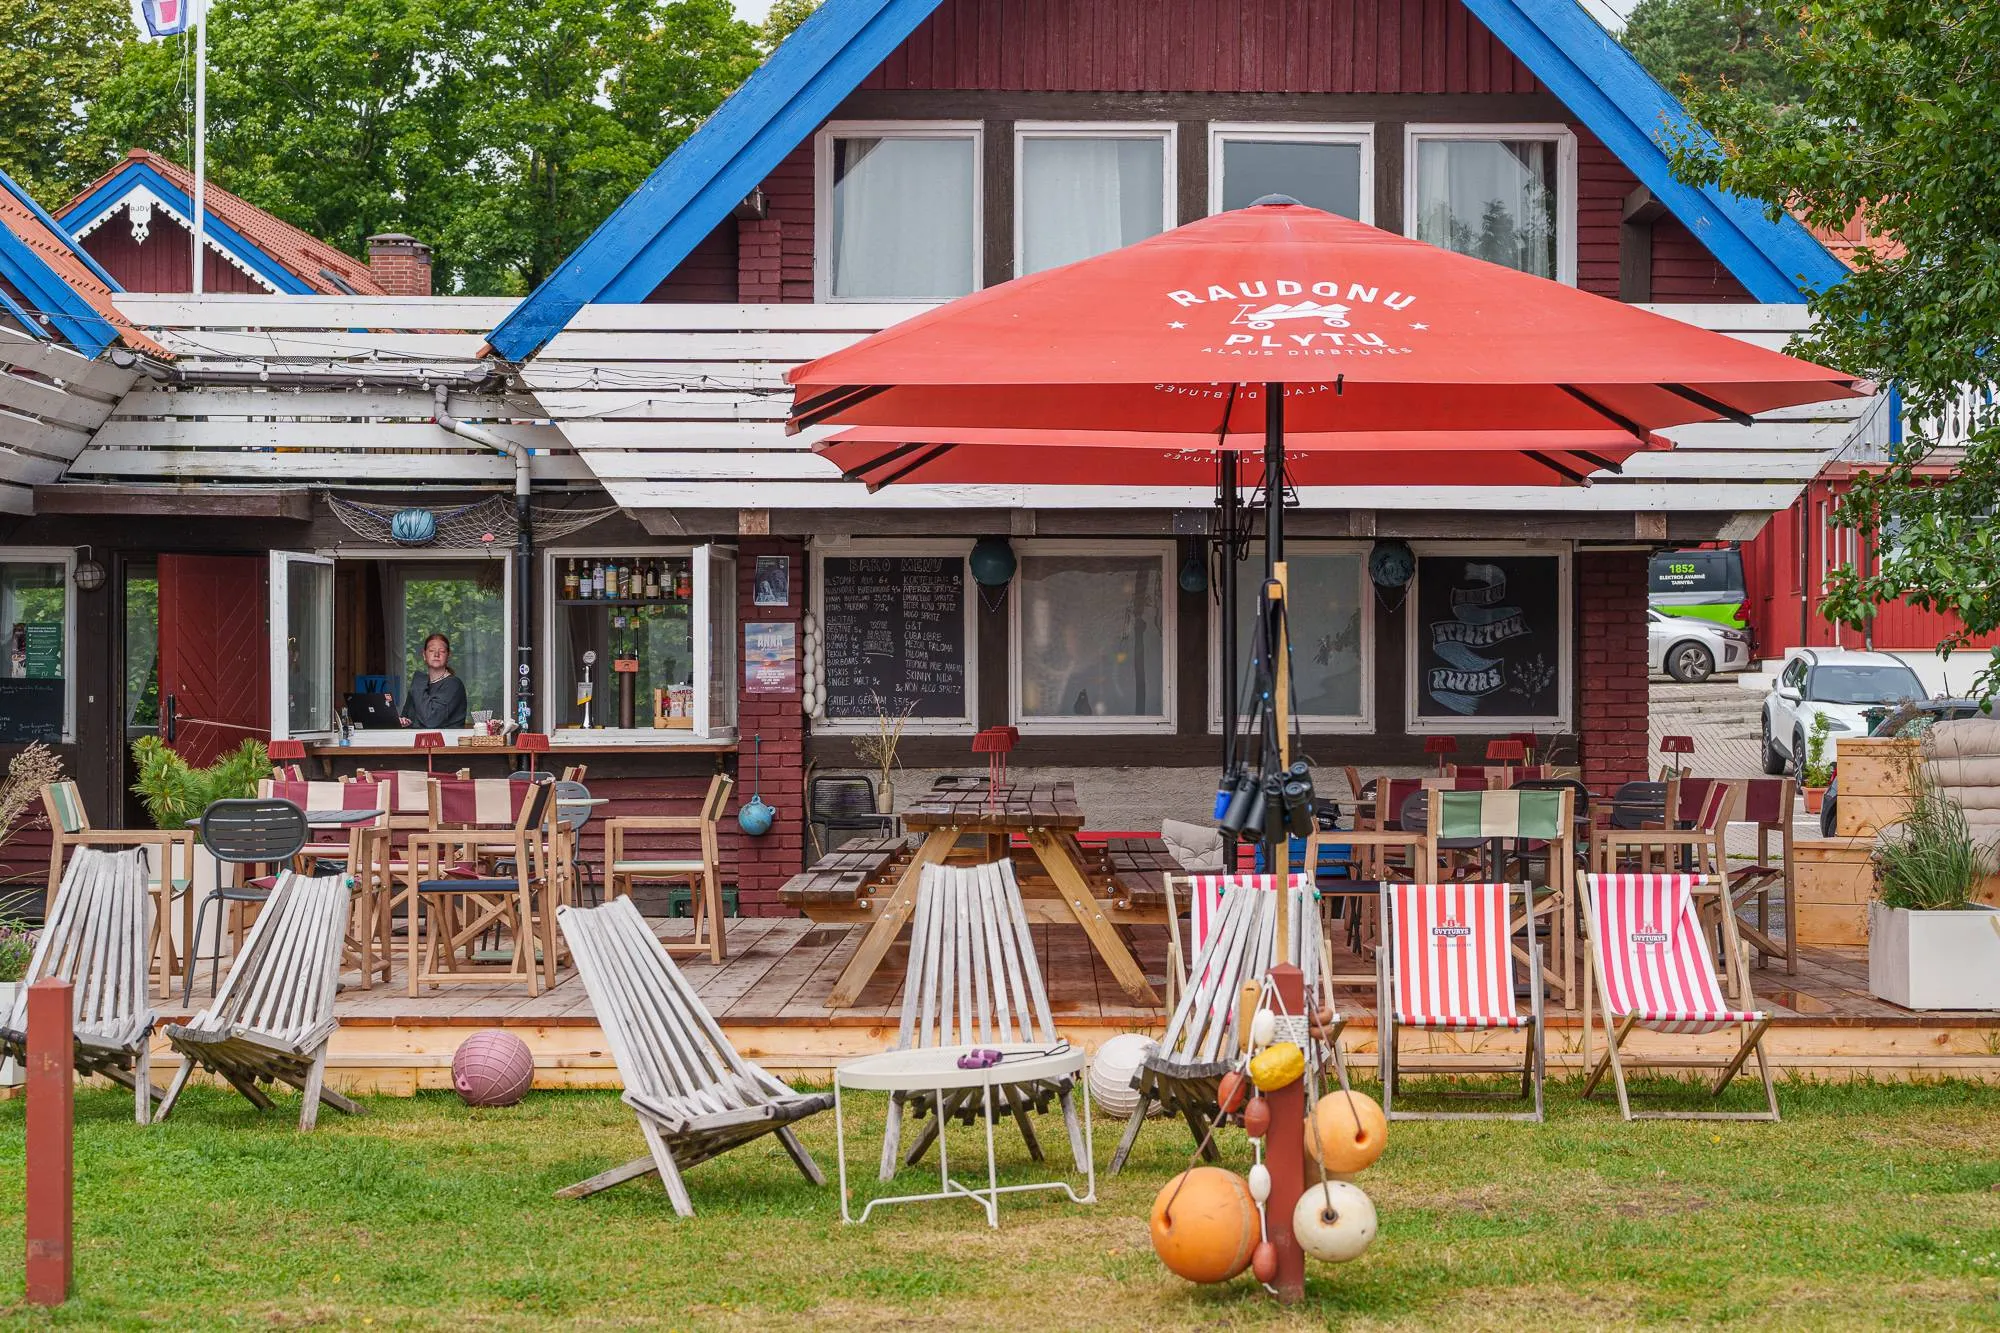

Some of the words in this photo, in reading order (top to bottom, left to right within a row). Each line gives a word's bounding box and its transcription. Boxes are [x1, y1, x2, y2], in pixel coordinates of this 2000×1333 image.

[1167, 280, 1416, 310] RAUDONŲ
[1225, 333, 1388, 348] PLYTŲ
[1201, 347, 1273, 356] ALAUS
[1669, 564, 1695, 573] 1852
[903, 601, 919, 609] BITTER
[904, 610, 918, 618] HUGO
[905, 621, 922, 631] G&T
[904, 631, 921, 640] CUBA
[758, 634, 783, 648] ANNA
[929, 642, 953, 652] PALOMA
[827, 650, 847, 658] TEKILA
[905, 649, 929, 659] PALOMA
[827, 667, 848, 676] VISKIS
[906, 669, 931, 681] SKINNY
[828, 677, 850, 686] SINGLE
[853, 676, 870, 686] MALT
[1433, 668, 1501, 692] KLUBAS
[904, 683, 918, 692] NON
[938, 685, 961, 694] SPRITZ
